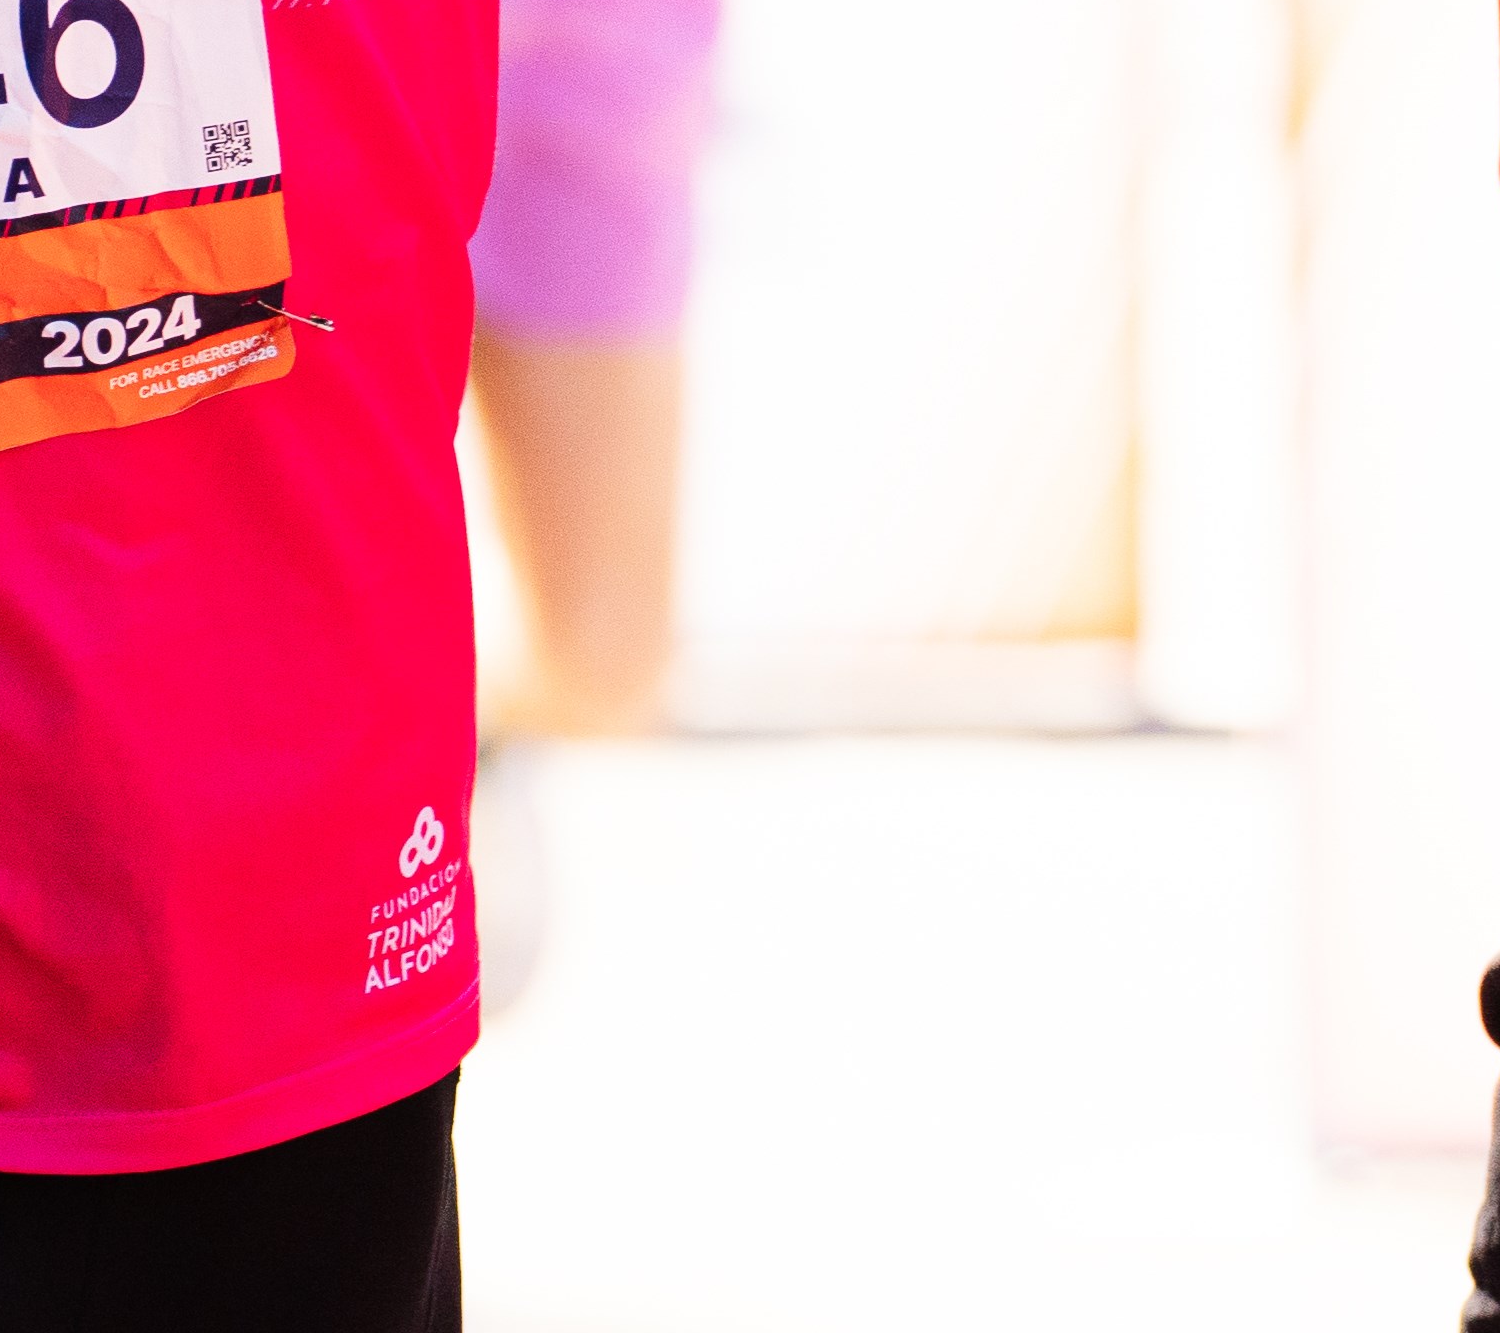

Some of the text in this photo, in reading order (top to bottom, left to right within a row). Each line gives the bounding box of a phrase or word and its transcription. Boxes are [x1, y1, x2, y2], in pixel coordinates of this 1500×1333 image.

[3, 155, 47, 204] A
[41, 294, 202, 371] 2024
[110, 372, 138, 390] FOR
[142, 359, 180, 379] RACE
[139, 379, 177, 398] CALL
